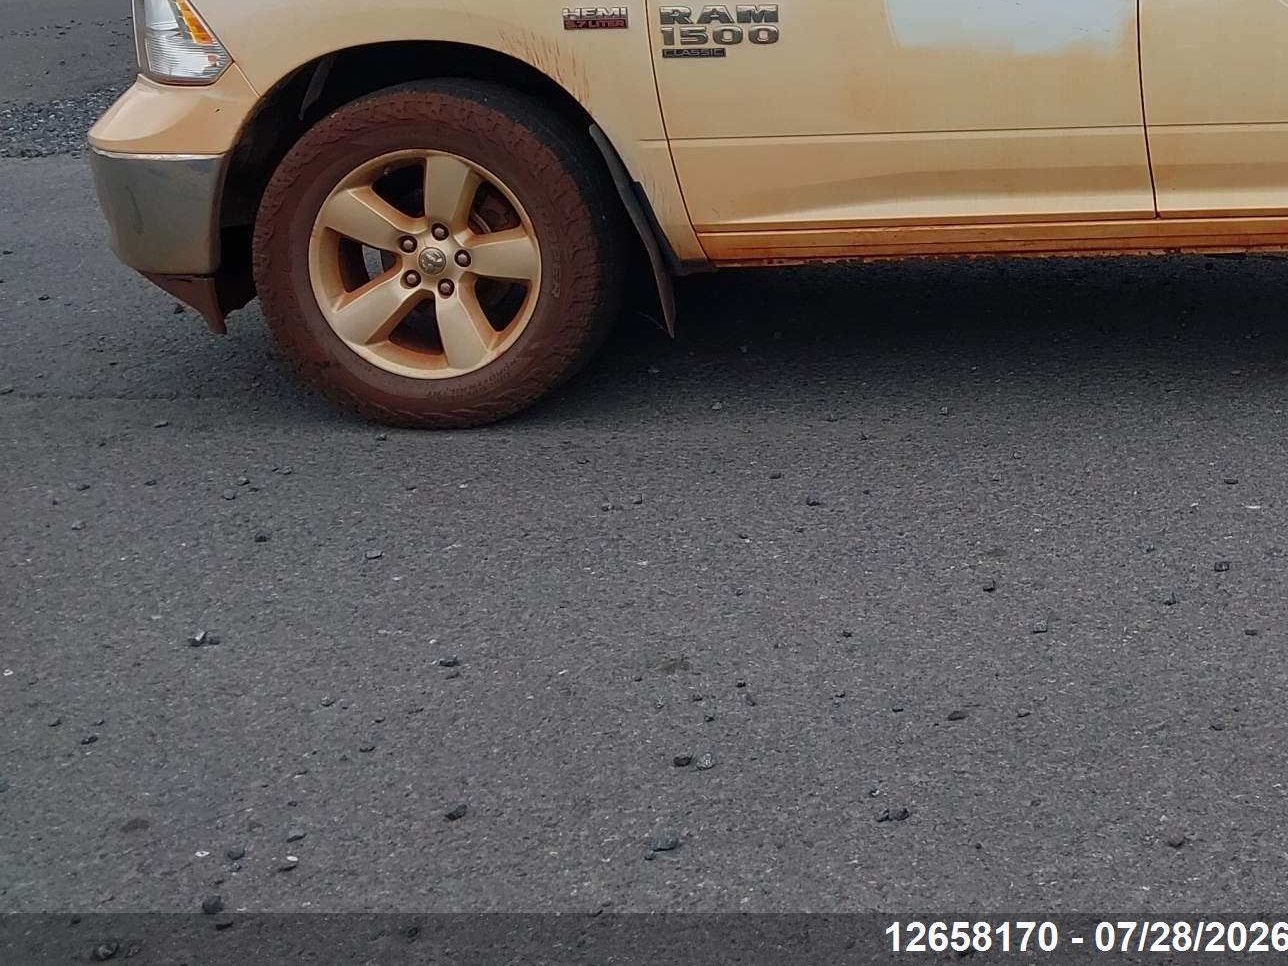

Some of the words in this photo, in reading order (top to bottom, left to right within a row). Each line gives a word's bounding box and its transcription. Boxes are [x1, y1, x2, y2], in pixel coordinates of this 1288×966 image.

[561, 6, 628, 19] HEMI
[659, 4, 779, 25] RAM
[659, 24, 780, 46] 1500
[663, 47, 726, 58] CLASSIC
